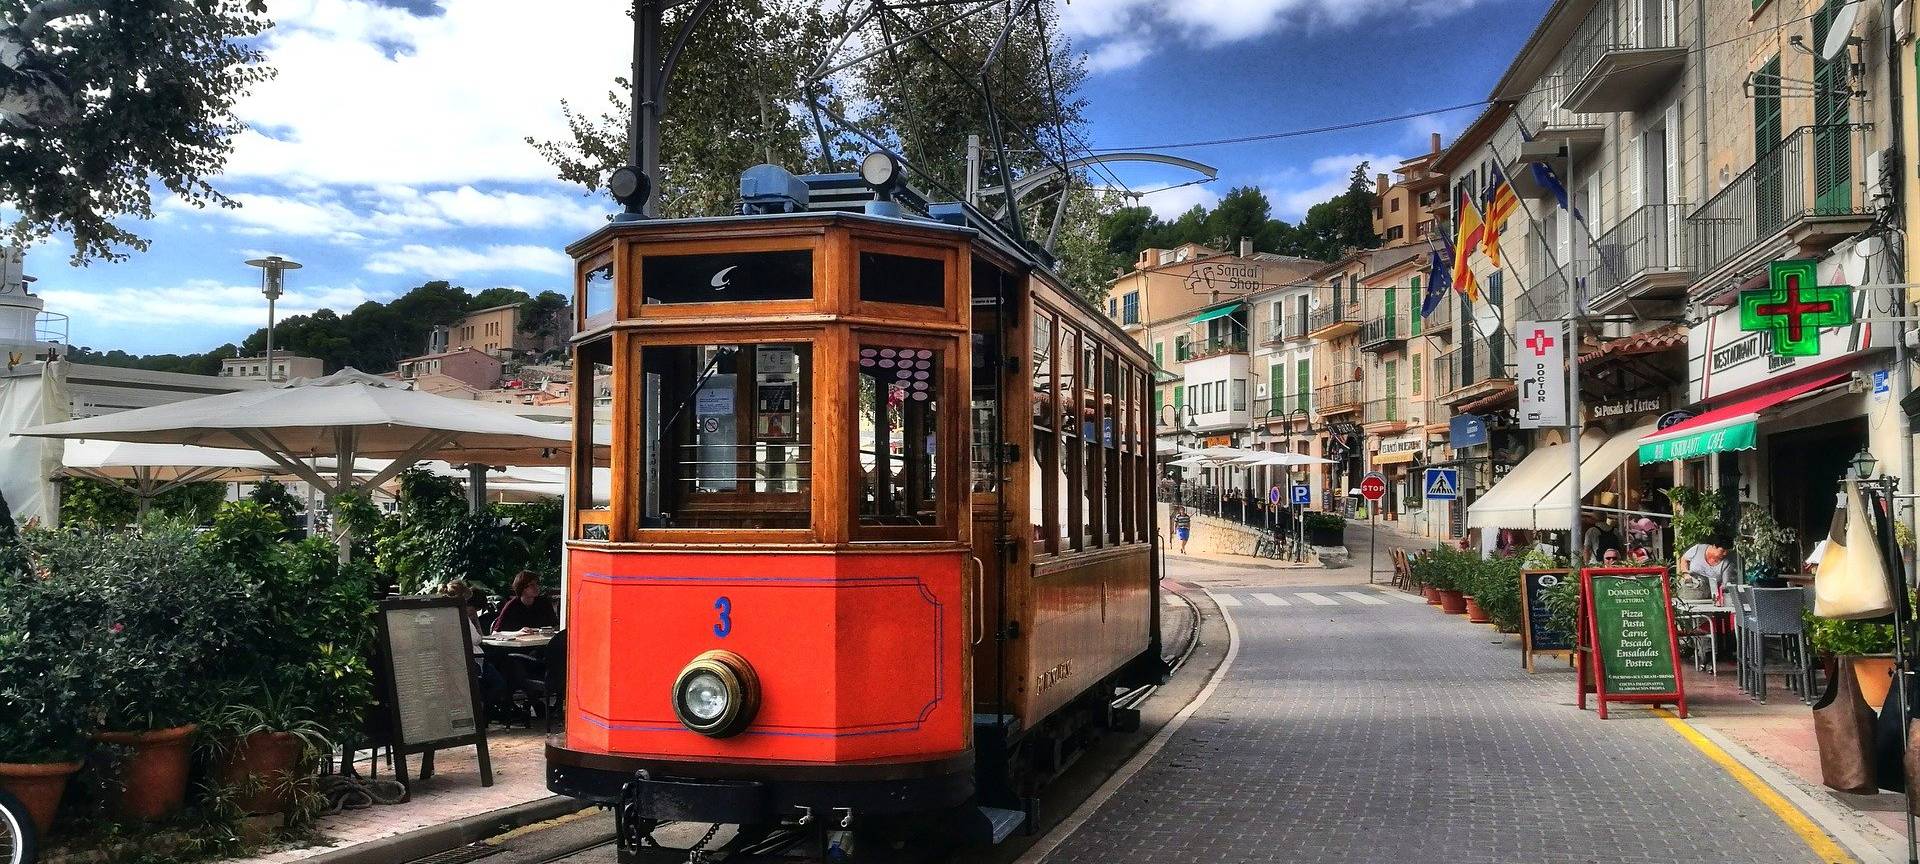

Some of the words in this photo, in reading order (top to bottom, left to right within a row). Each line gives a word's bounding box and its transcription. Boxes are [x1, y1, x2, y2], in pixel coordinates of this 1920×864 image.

[1217, 265, 1258, 277] Sandal
[1230, 277, 1259, 292] Shop
[1537, 363, 1546, 402] DOCTOR
[1594, 406, 1602, 417] Sa
[1603, 402, 1623, 417] Posada
[1625, 400, 1633, 413] de
[1495, 464, 1504, 473] Sa
[1295, 486, 1308, 502] P
[713, 596, 732, 638] 3
[1621, 609, 1644, 618] Pizza
[1622, 619, 1645, 628] Pasta
[1622, 629, 1648, 638] Carne
[1620, 637, 1652, 648] Pescado
[1616, 647, 1660, 658] Ensaladas
[1625, 659, 1654, 668] Postres
